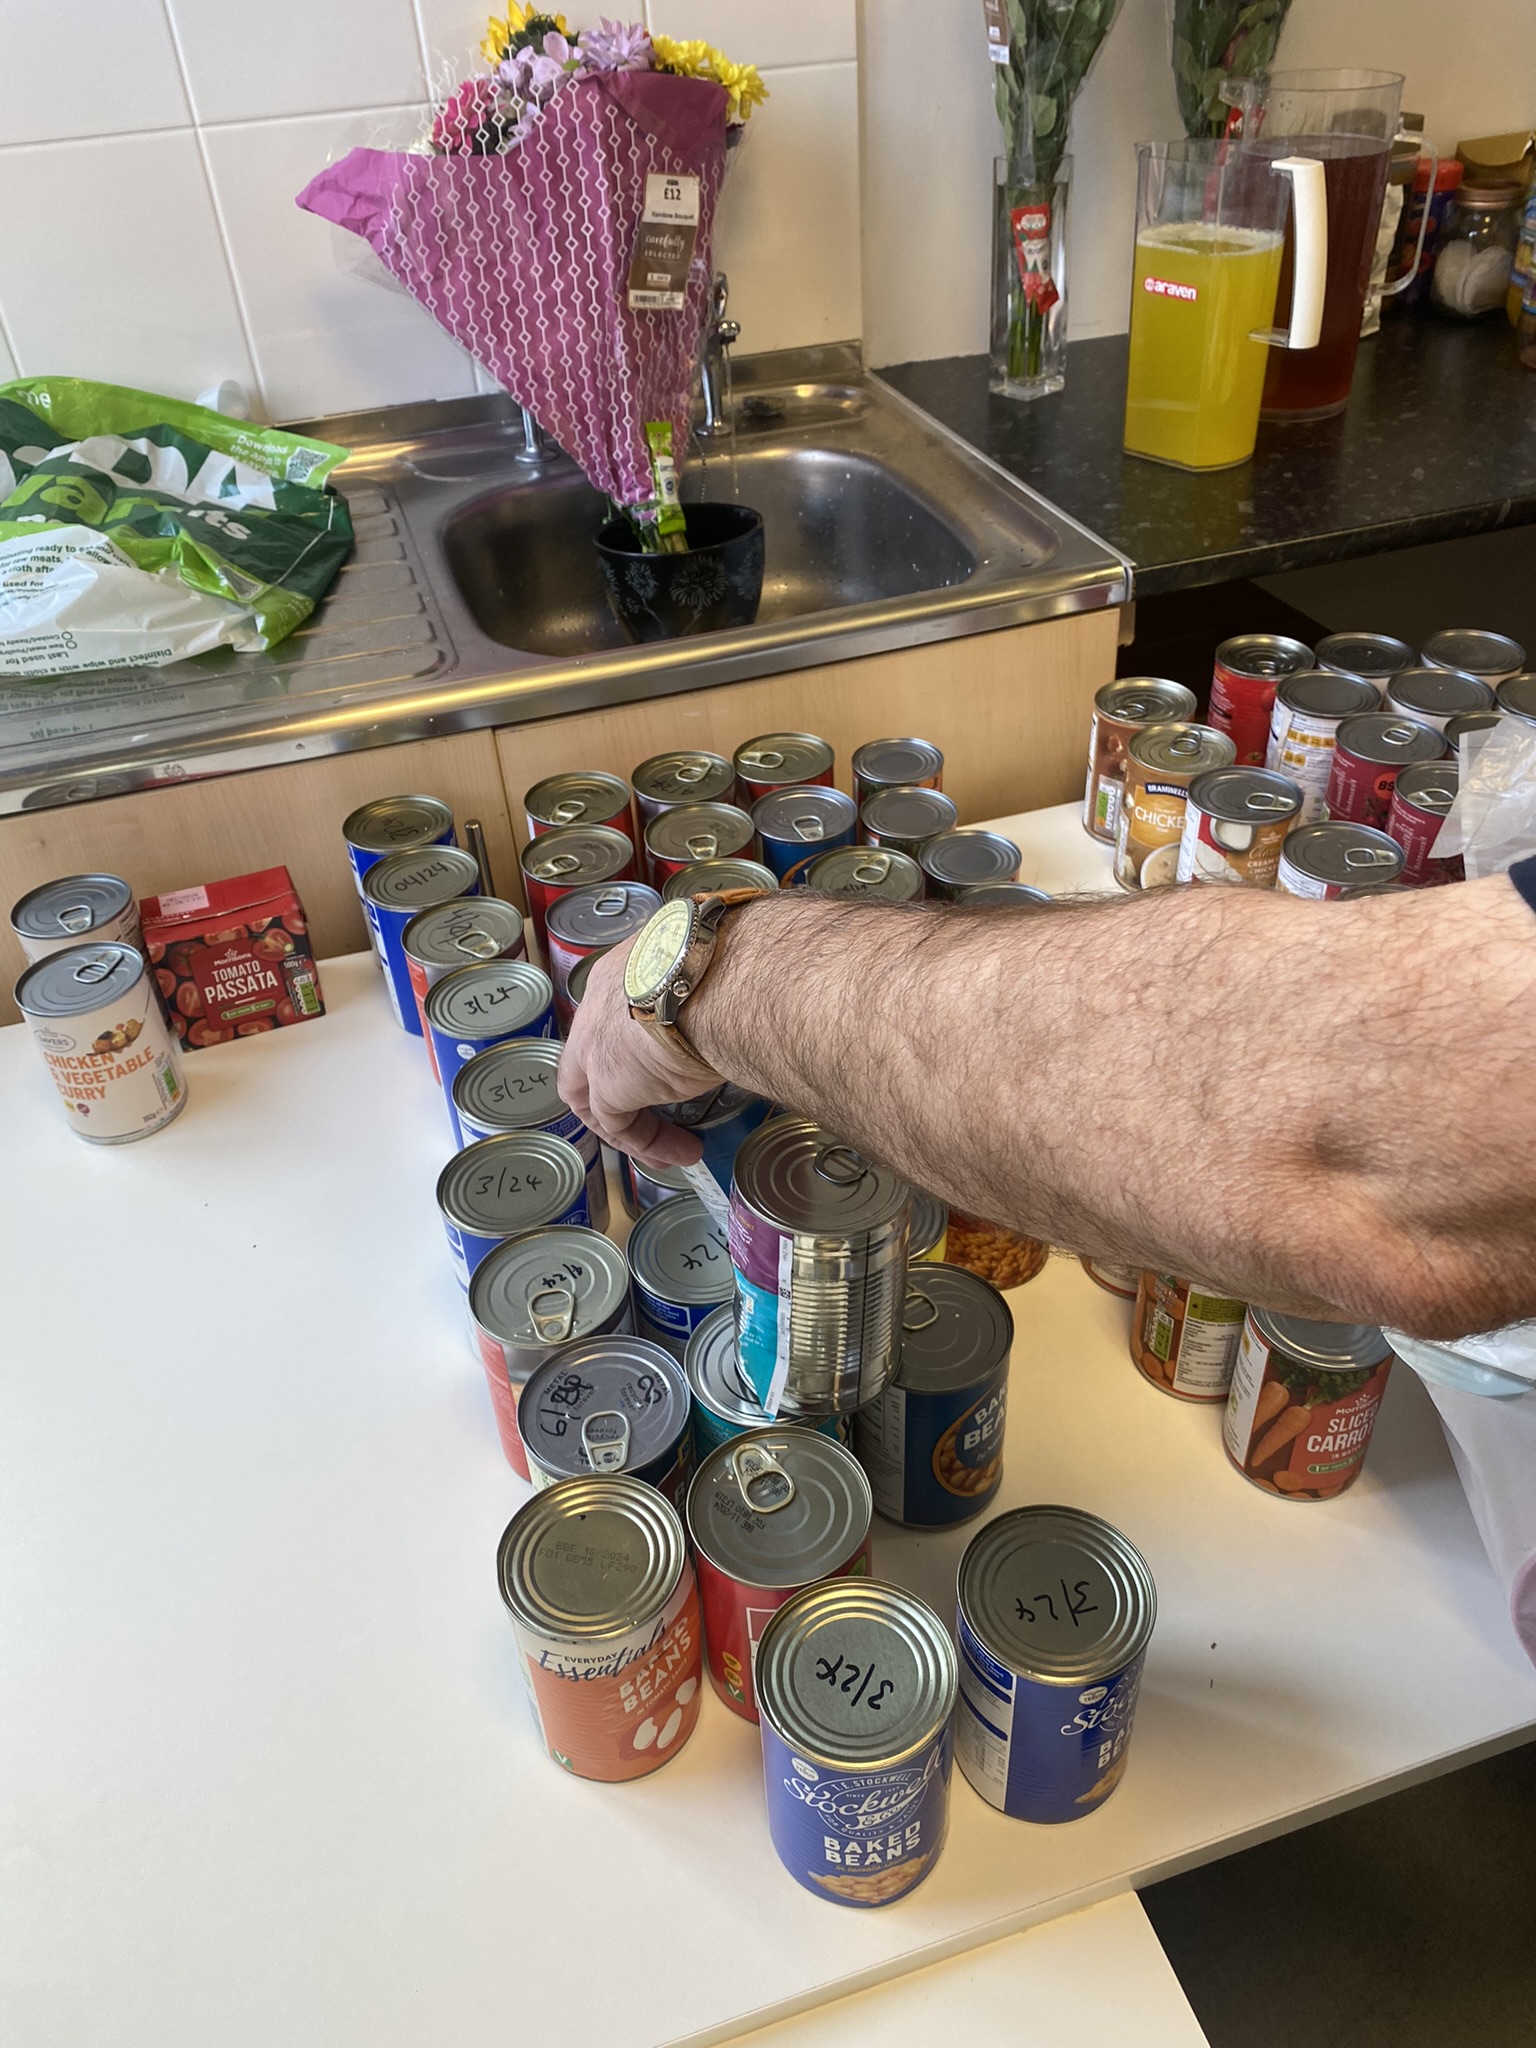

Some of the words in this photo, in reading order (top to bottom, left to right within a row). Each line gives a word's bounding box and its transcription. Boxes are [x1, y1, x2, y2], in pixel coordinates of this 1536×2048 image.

[664, 187, 681, 201] £12
[645, 233, 685, 251] carefully
[1153, 280, 1197, 301] araven
[30, 554, 63, 564] meats,
[35, 544, 63, 554] ready
[65, 545, 77, 553] to
[8, 564, 33, 573] cloth
[35, 565, 55, 574] afte
[5, 658, 20, 666] for
[22, 654, 45, 664] used
[48, 651, 69, 661] Last
[82, 660, 106, 669] wipe
[108, 657, 126, 666] and
[129, 648, 172, 663] Disinfect
[58, 664, 81, 673] with
[1134, 805, 1186, 829] CHICKE
[394, 860, 449, 892] 04/24
[211, 960, 261, 983] TOMATO
[204, 970, 279, 1005] PASSATA
[464, 985, 518, 1016] 3/24
[43, 1051, 115, 1070] CHICKEN
[60, 1045, 155, 1086] VEGETABLE
[56, 1082, 107, 1101] CURRY
[489, 1072, 549, 1104] 3/24
[476, 1166, 543, 1199] 3/24
[1306, 1419, 1375, 1453] CARROT
[1014, 1578, 1099, 1628] 3/24
[538, 1616, 666, 1683] Essentials
[564, 1651, 618, 1664] EVERYDAY
[619, 1616, 688, 1700] BAKED
[623, 1629, 691, 1714] BEANS
[783, 1743, 944, 1816] Stockwell
[861, 1815, 875, 1827] &
[823, 1820, 921, 1851] BAKED
[841, 1827, 884, 1837] QUALITY
[825, 1836, 921, 1867] BEANS
